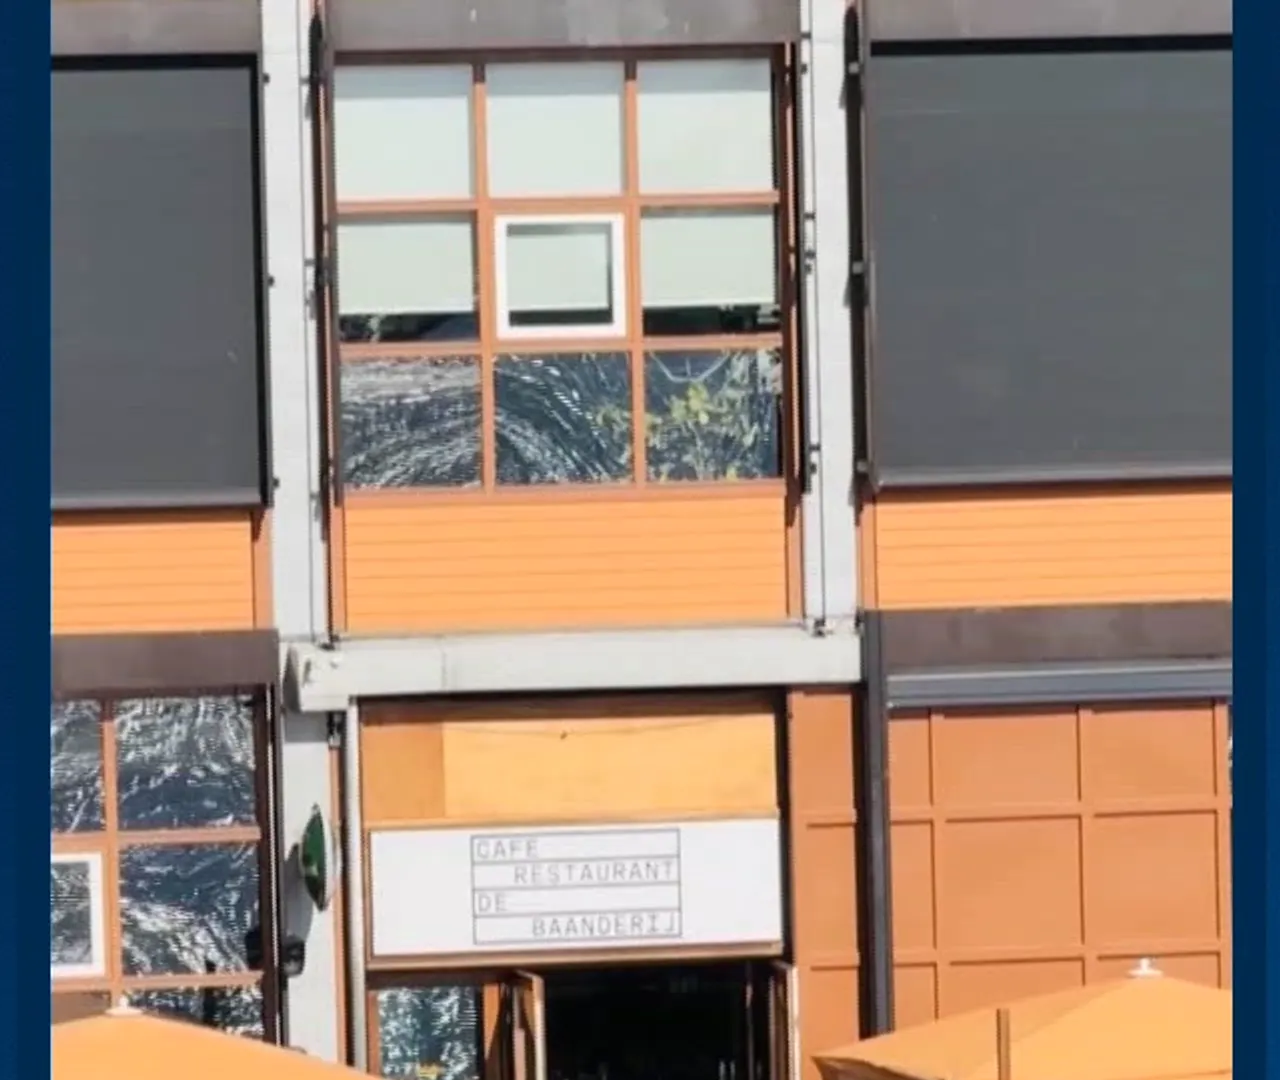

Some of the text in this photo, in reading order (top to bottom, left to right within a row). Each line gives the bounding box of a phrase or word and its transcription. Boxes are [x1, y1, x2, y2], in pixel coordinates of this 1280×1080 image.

[476, 839, 539, 859] CAFE
[513, 860, 673, 884] RESTAURANT
[477, 893, 507, 912] DE
[532, 913, 676, 937] BAANDERIJ
